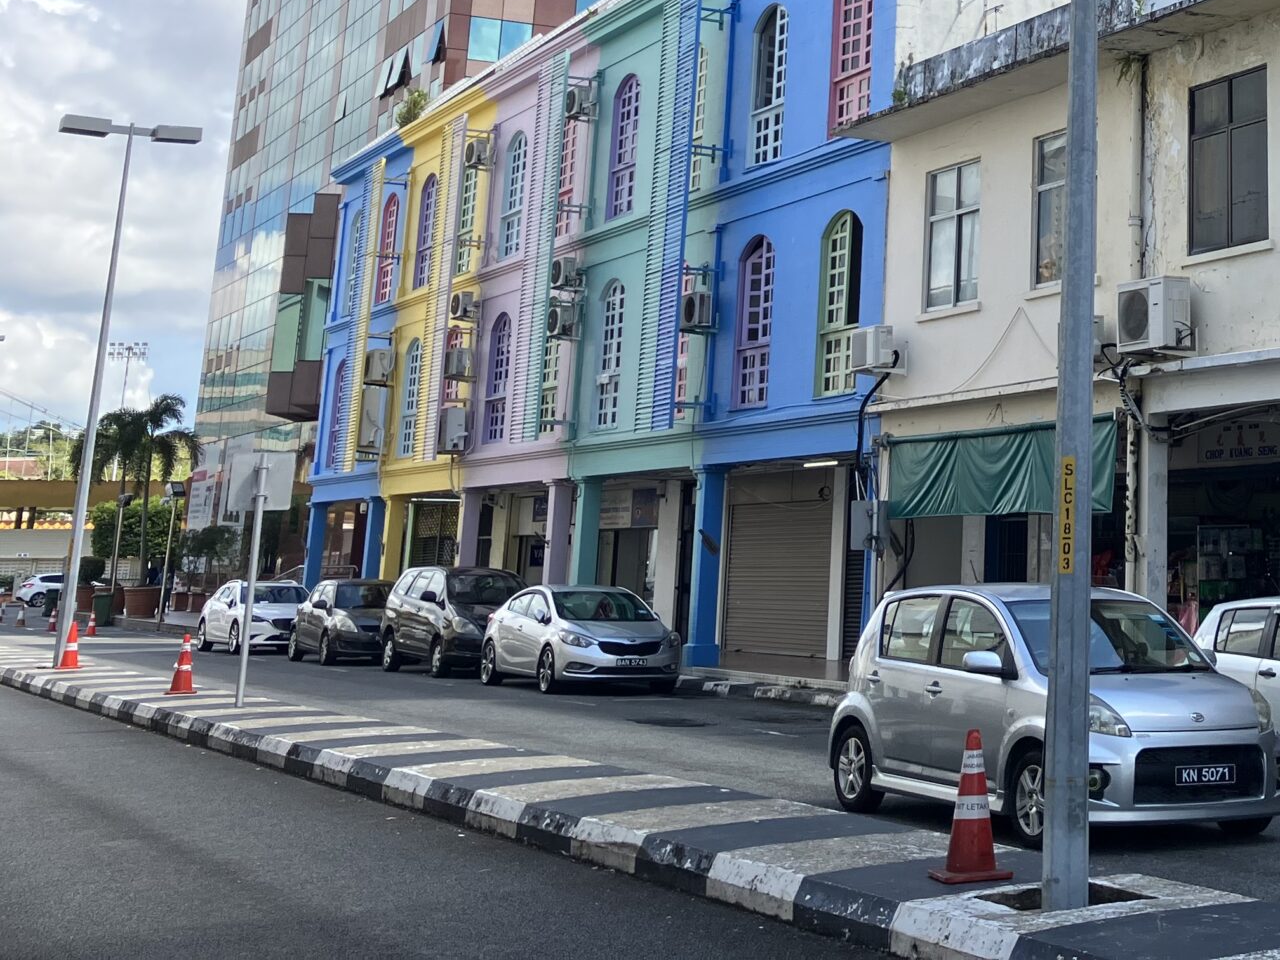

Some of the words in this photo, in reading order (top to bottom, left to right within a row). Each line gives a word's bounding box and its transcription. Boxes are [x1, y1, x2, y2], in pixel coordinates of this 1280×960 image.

[1205, 448, 1224, 460] CHOP
[1229, 447, 1253, 458] KUANG
[1258, 445, 1278, 456] SENG
[1182, 768, 1198, 783] KN
[1201, 767, 1229, 782] 5071
